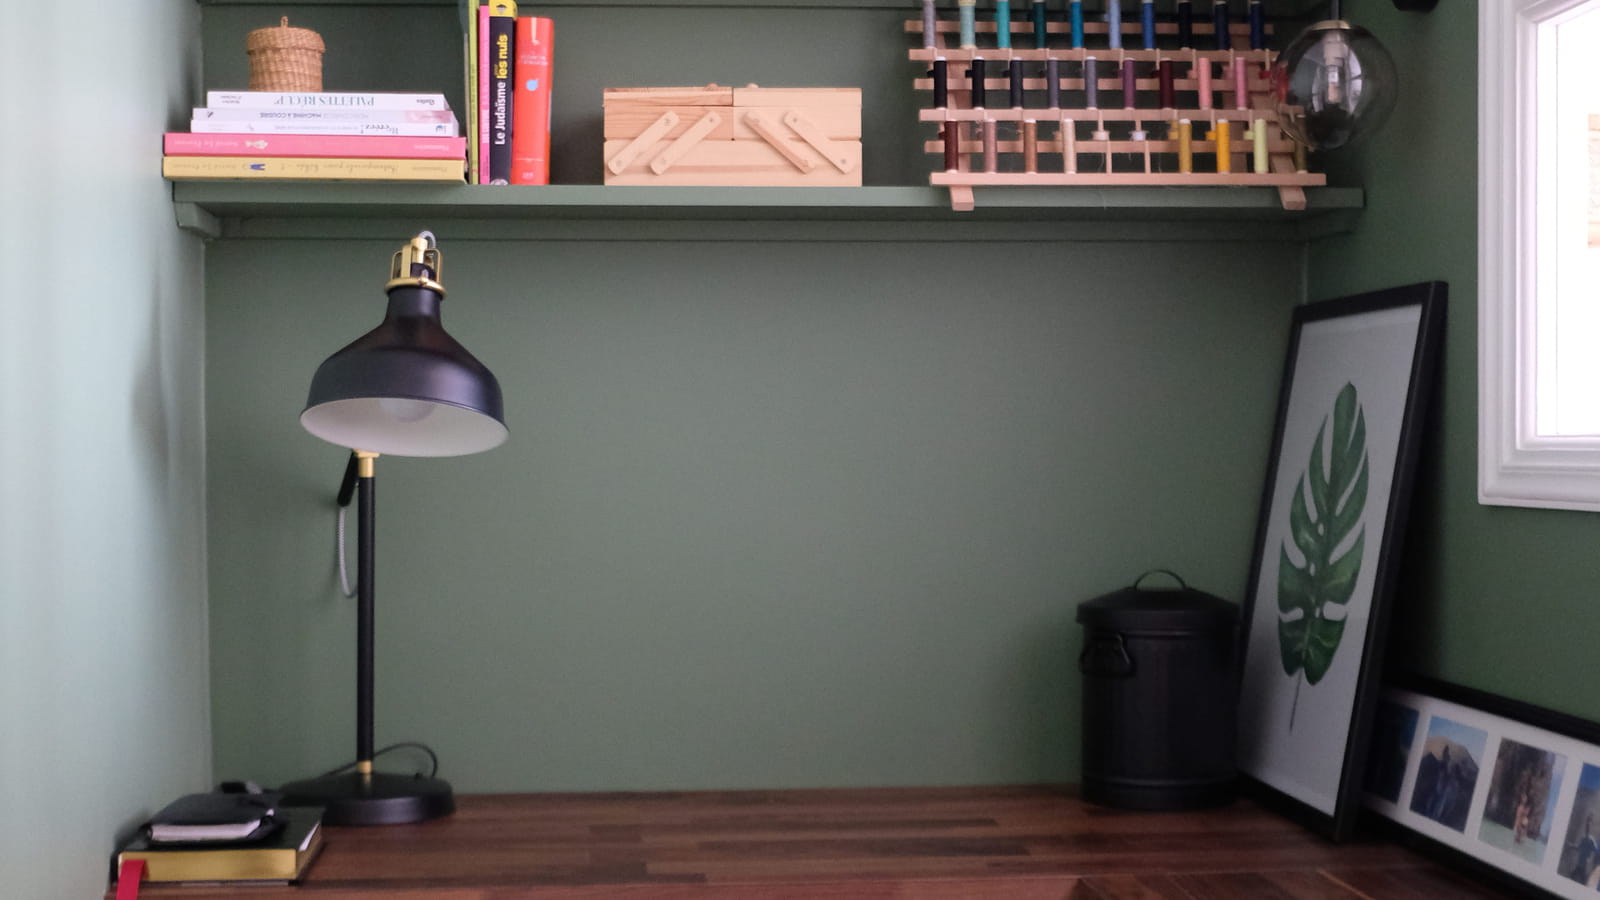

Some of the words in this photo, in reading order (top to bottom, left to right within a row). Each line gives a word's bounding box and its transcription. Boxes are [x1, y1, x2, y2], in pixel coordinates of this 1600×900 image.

[496, 33, 508, 59] nuls
[496, 60, 508, 79] les
[319, 95, 375, 106] PALETTES
[494, 81, 506, 130] Judaïsme
[494, 131, 506, 145] Le
